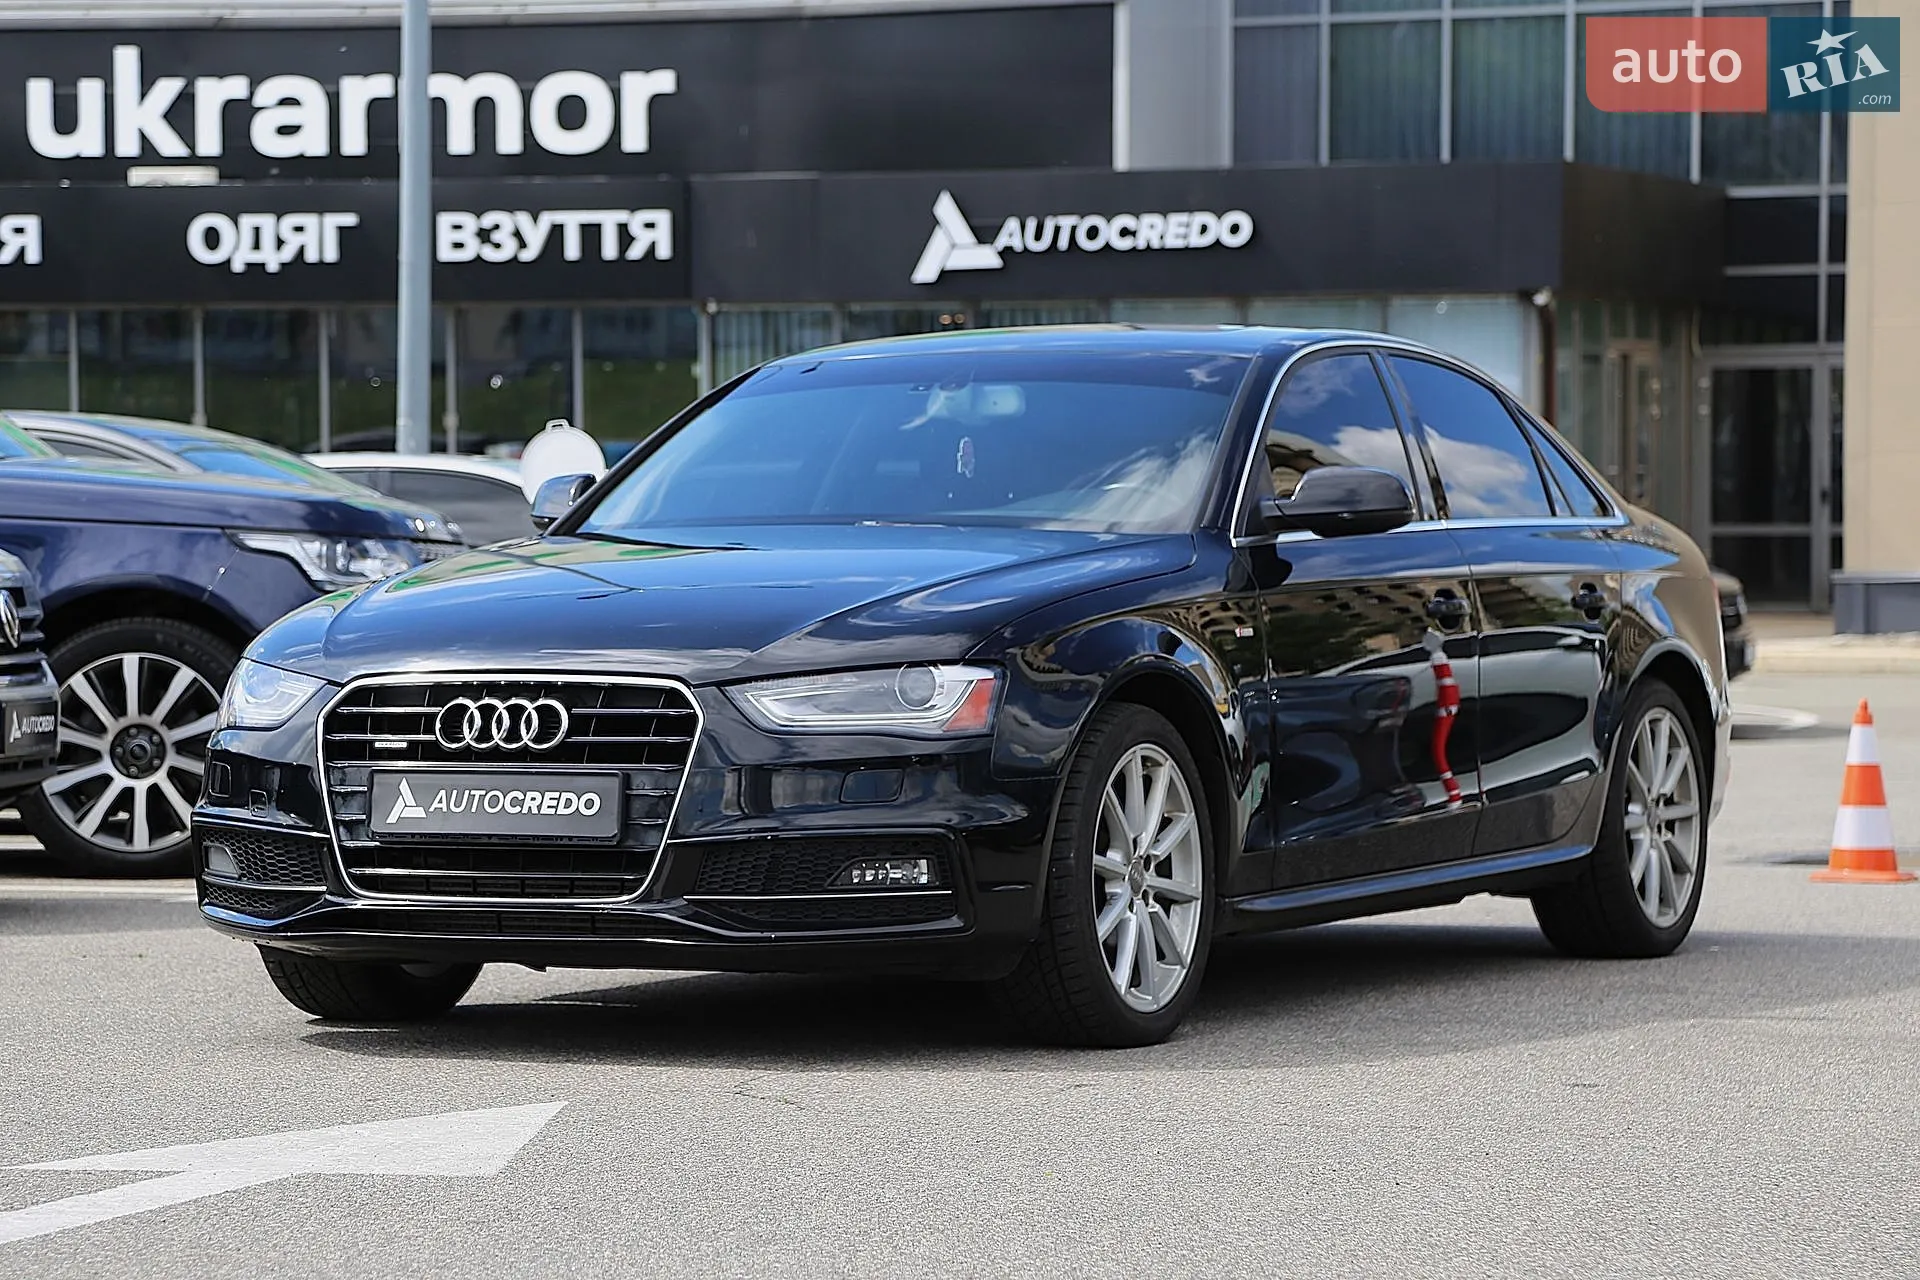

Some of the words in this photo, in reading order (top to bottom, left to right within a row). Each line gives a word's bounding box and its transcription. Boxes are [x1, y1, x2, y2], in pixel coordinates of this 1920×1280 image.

[26, 44, 678, 158] ukrarmor
[186, 212, 360, 273] ОДЯГ
[435, 208, 673, 262] ВЗУТТЯ
[996, 209, 1254, 253] AUTOCREDO
[428, 789, 601, 816] AUTOCREDO
